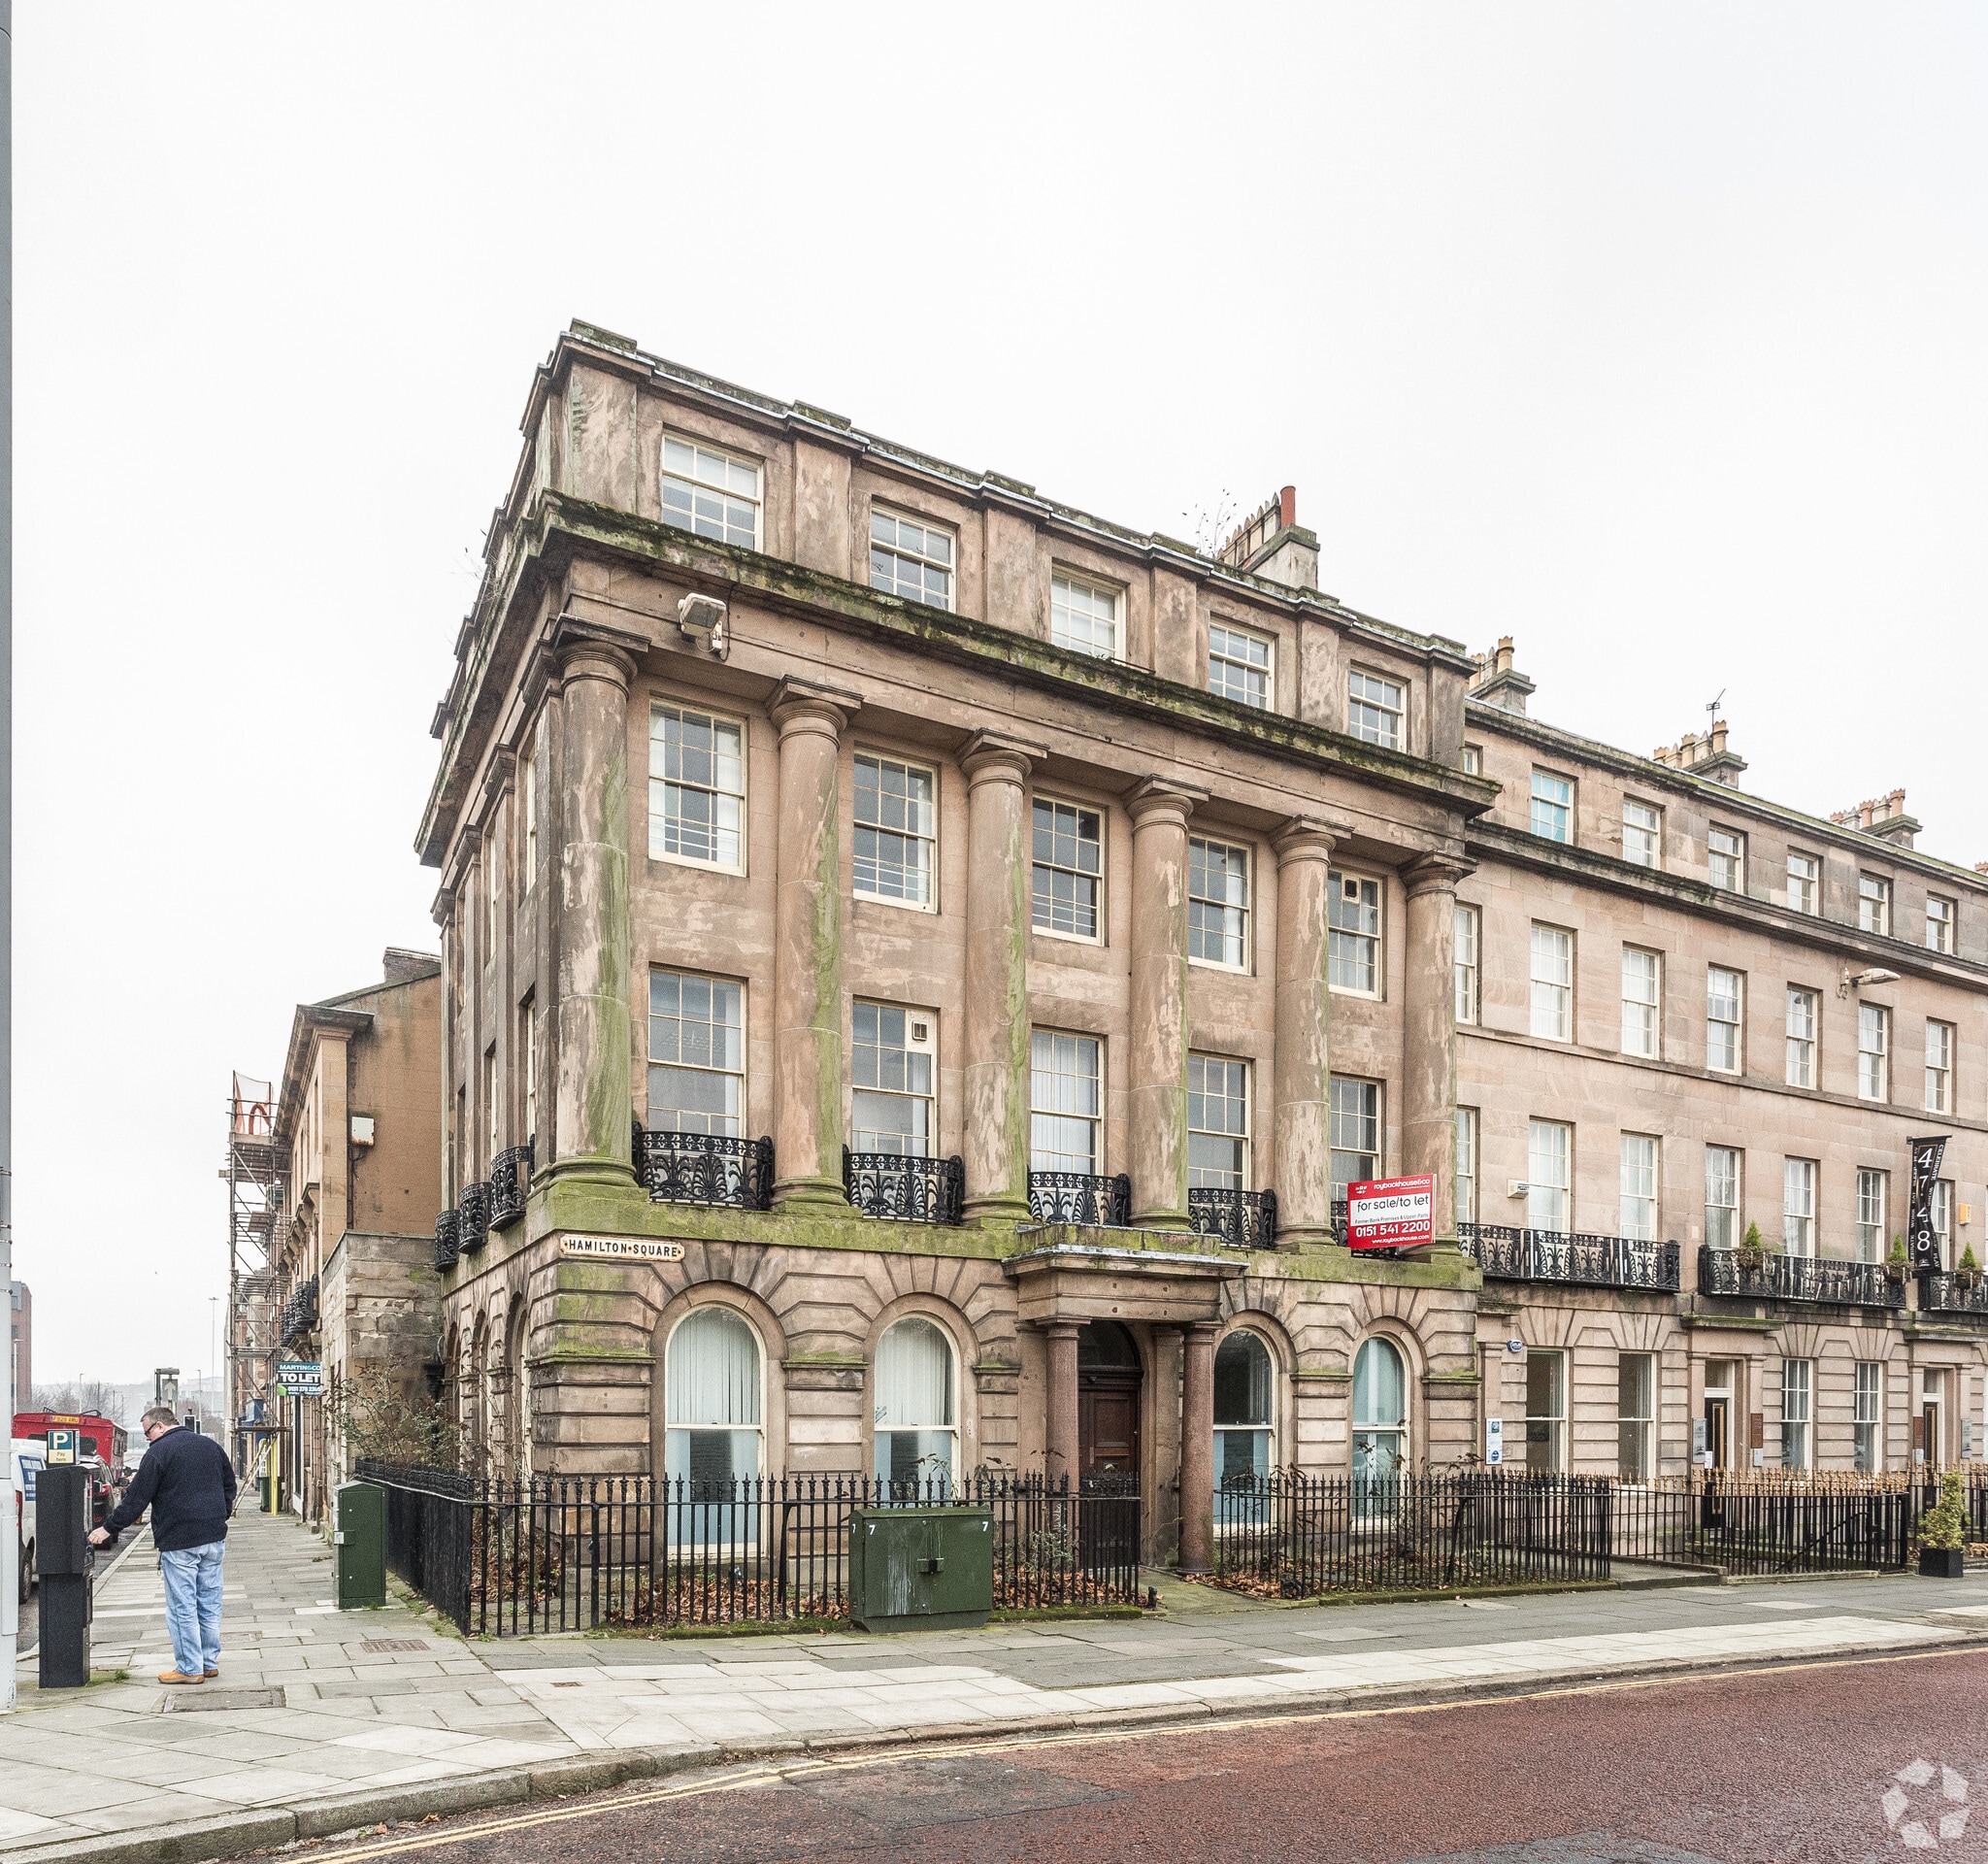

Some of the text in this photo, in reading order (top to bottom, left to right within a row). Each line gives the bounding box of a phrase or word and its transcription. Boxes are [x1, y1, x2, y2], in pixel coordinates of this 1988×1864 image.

[1932, 1144, 1944, 1181] CELEBRATE
[1357, 1195, 1429, 1213] for sale/to let
[1356, 1221, 1430, 1237] 0151 541 2200
[569, 1239, 678, 1257] HAMILTON SQUARE
[281, 1373, 320, 1383] TO LET
[53, 1432, 68, 1449] P
[869, 1524, 876, 1535] 7
[982, 1521, 988, 1532] 7
